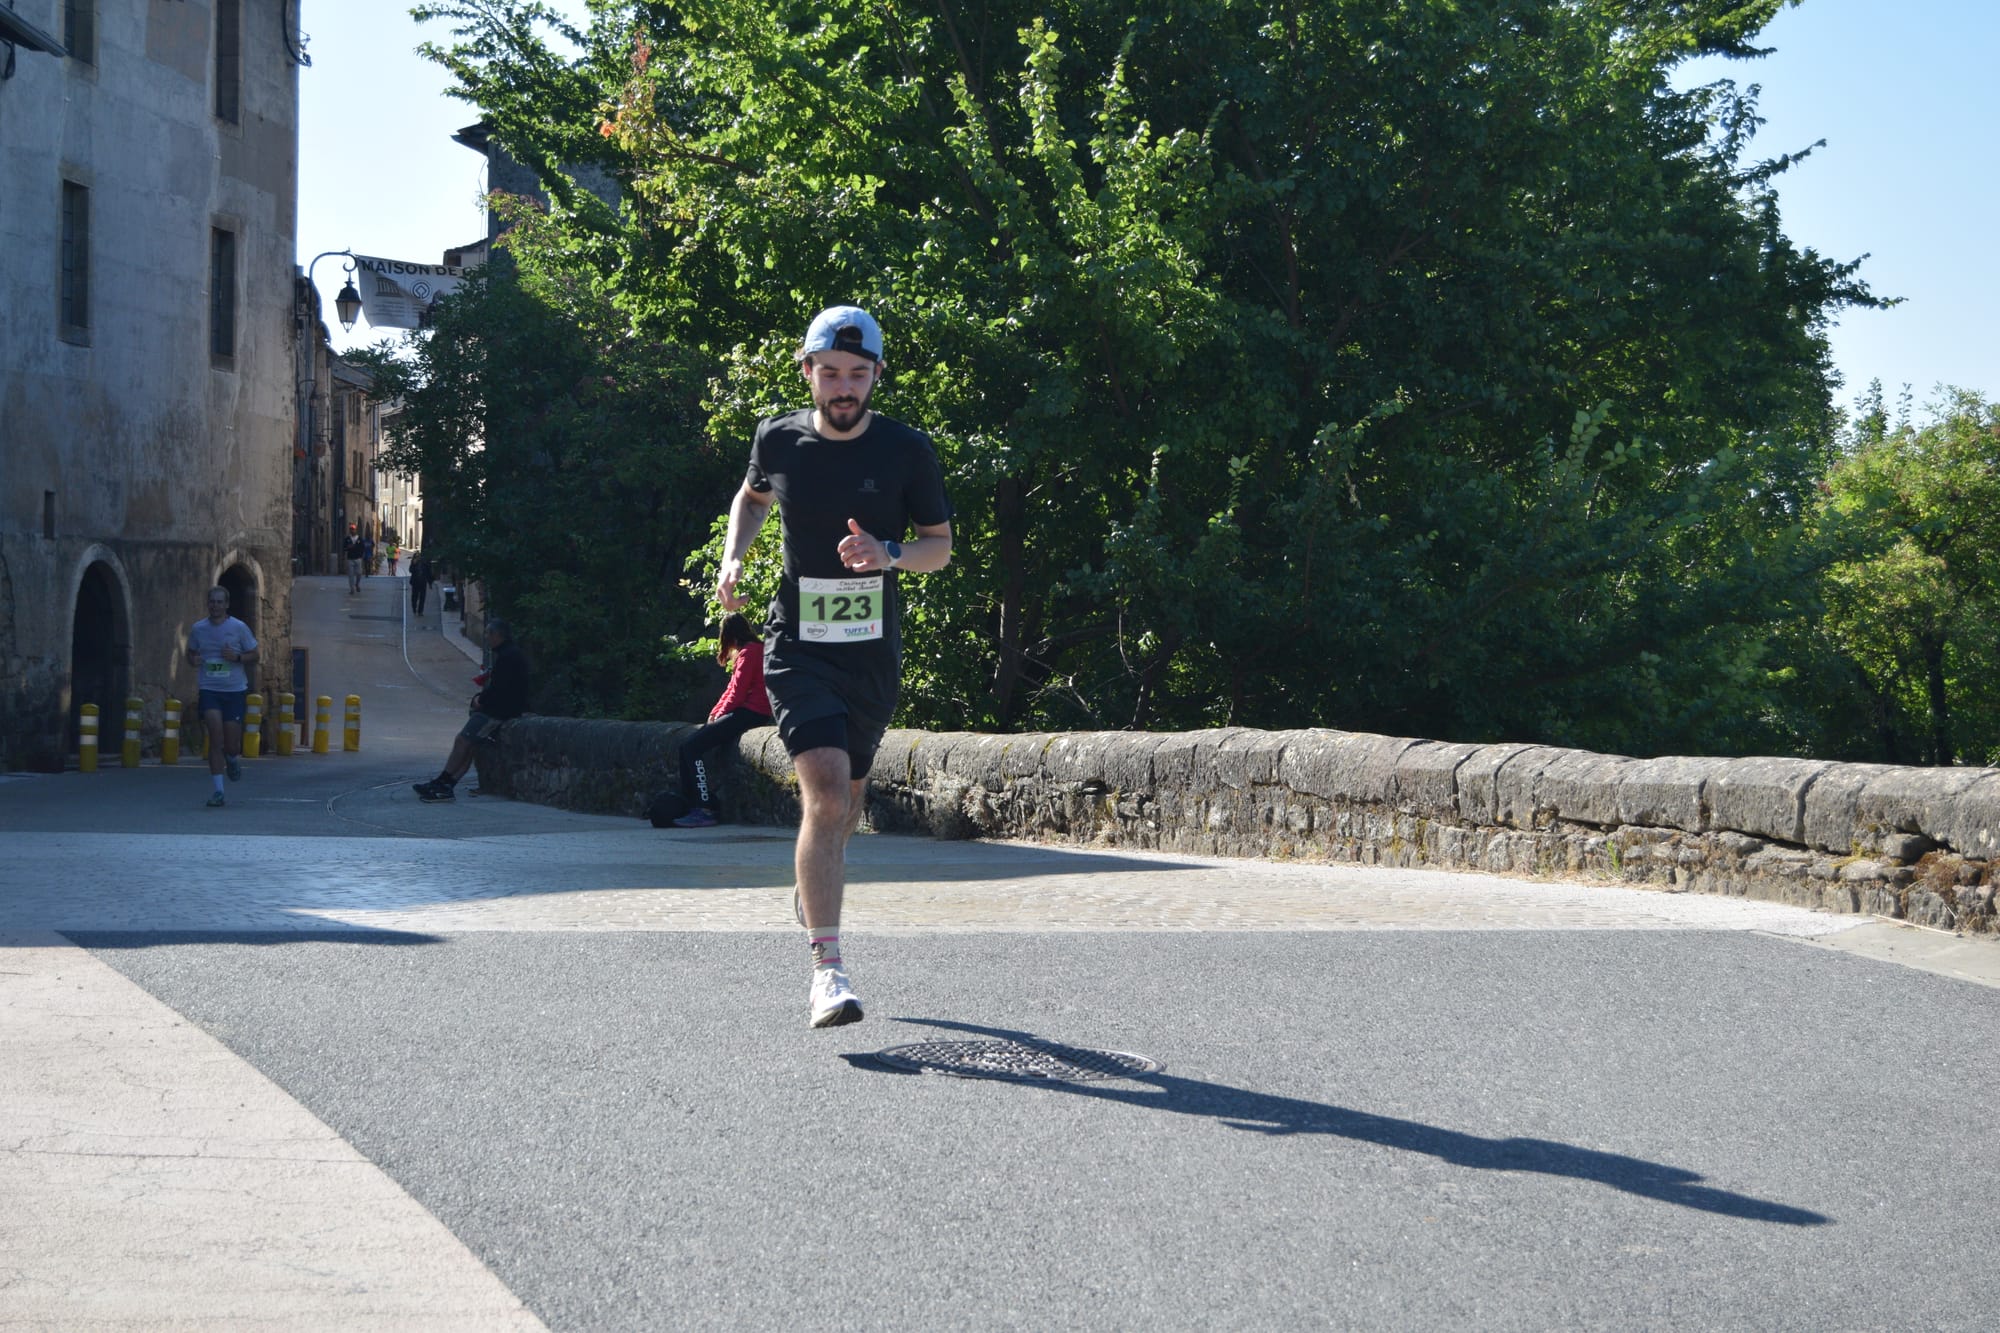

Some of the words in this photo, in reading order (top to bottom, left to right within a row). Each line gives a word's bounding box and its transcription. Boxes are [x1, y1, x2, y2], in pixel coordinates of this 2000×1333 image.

[362, 259, 430, 276] MAISON
[435, 265, 459, 277] DE
[811, 595, 872, 621] 123
[695, 759, 709, 801] adidas
